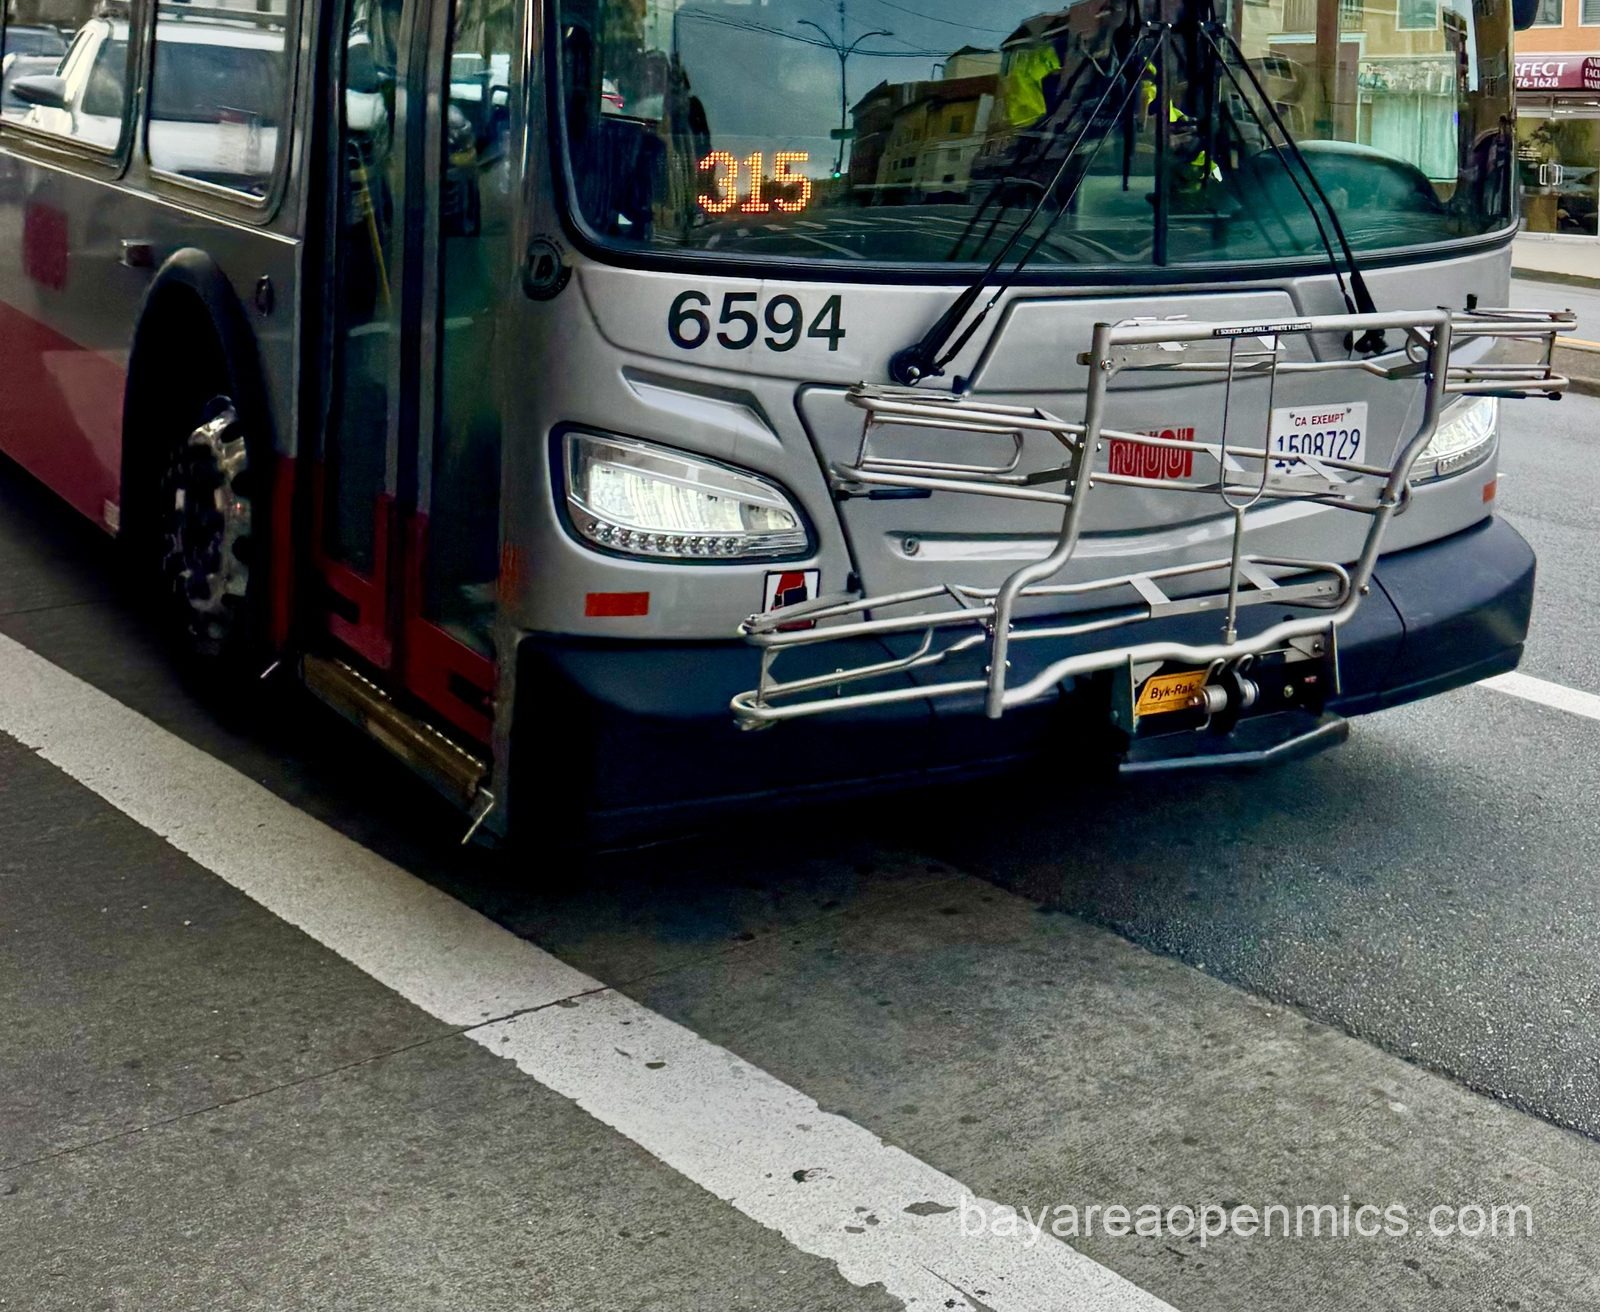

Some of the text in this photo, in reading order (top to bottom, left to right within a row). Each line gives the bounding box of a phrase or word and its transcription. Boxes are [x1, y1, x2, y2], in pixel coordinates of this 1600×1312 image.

[698, 151, 812, 212] 315
[668, 290, 846, 352] 6594
[1294, 413, 1345, 426] CA EXEMPT
[1275, 428, 1361, 467] 1508729
